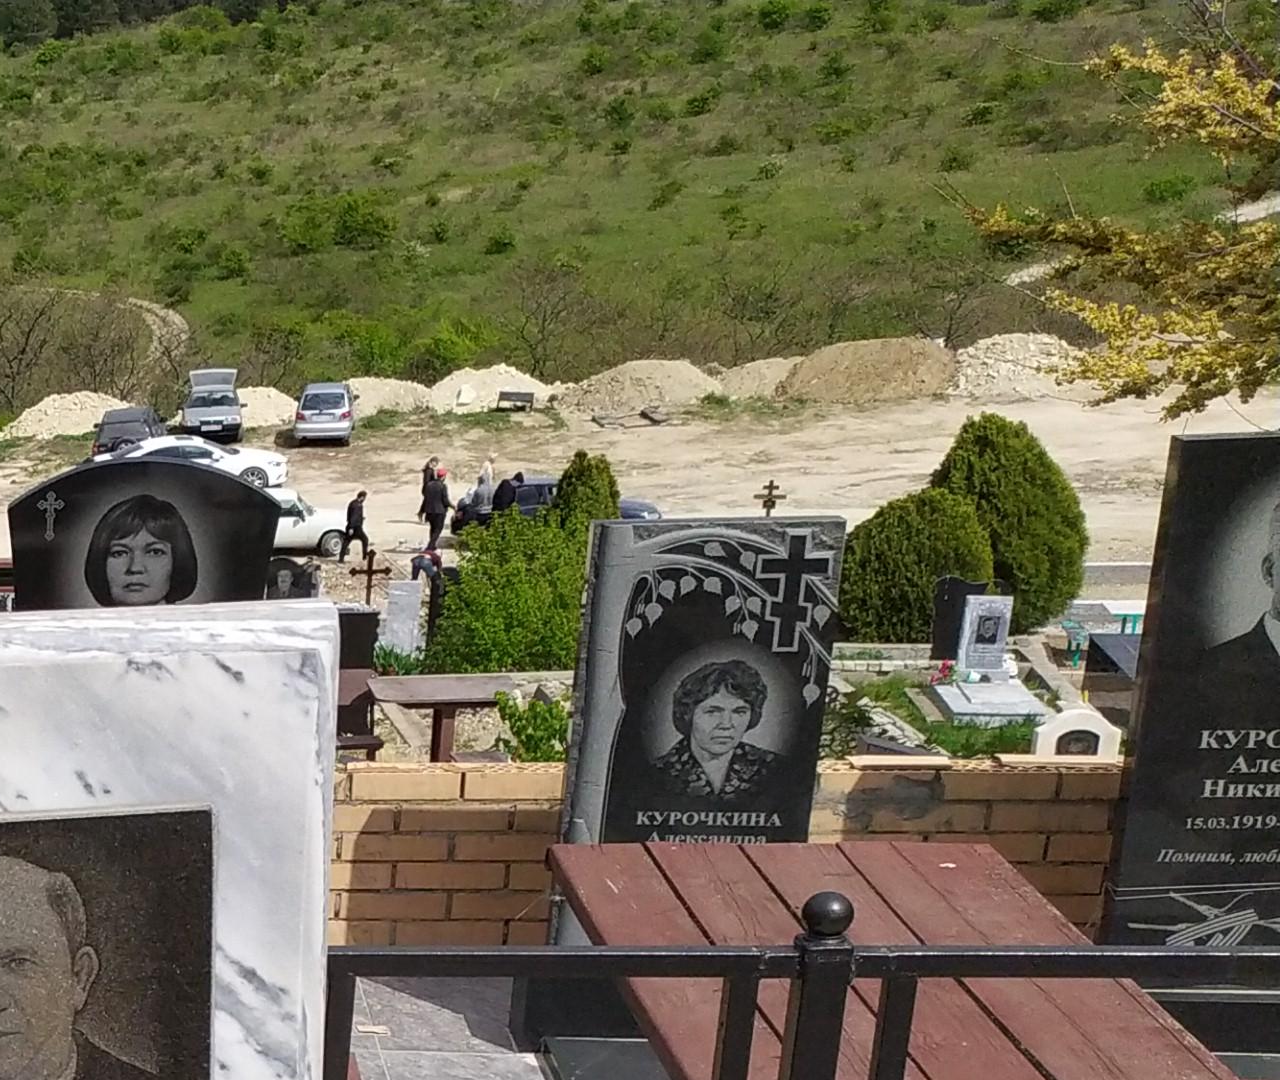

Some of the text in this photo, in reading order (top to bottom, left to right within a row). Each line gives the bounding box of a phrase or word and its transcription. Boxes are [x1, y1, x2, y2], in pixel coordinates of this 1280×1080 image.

[635, 810, 783, 828] КУРОЧКИНА
[1156, 848, 1280, 865] Помним, люб
